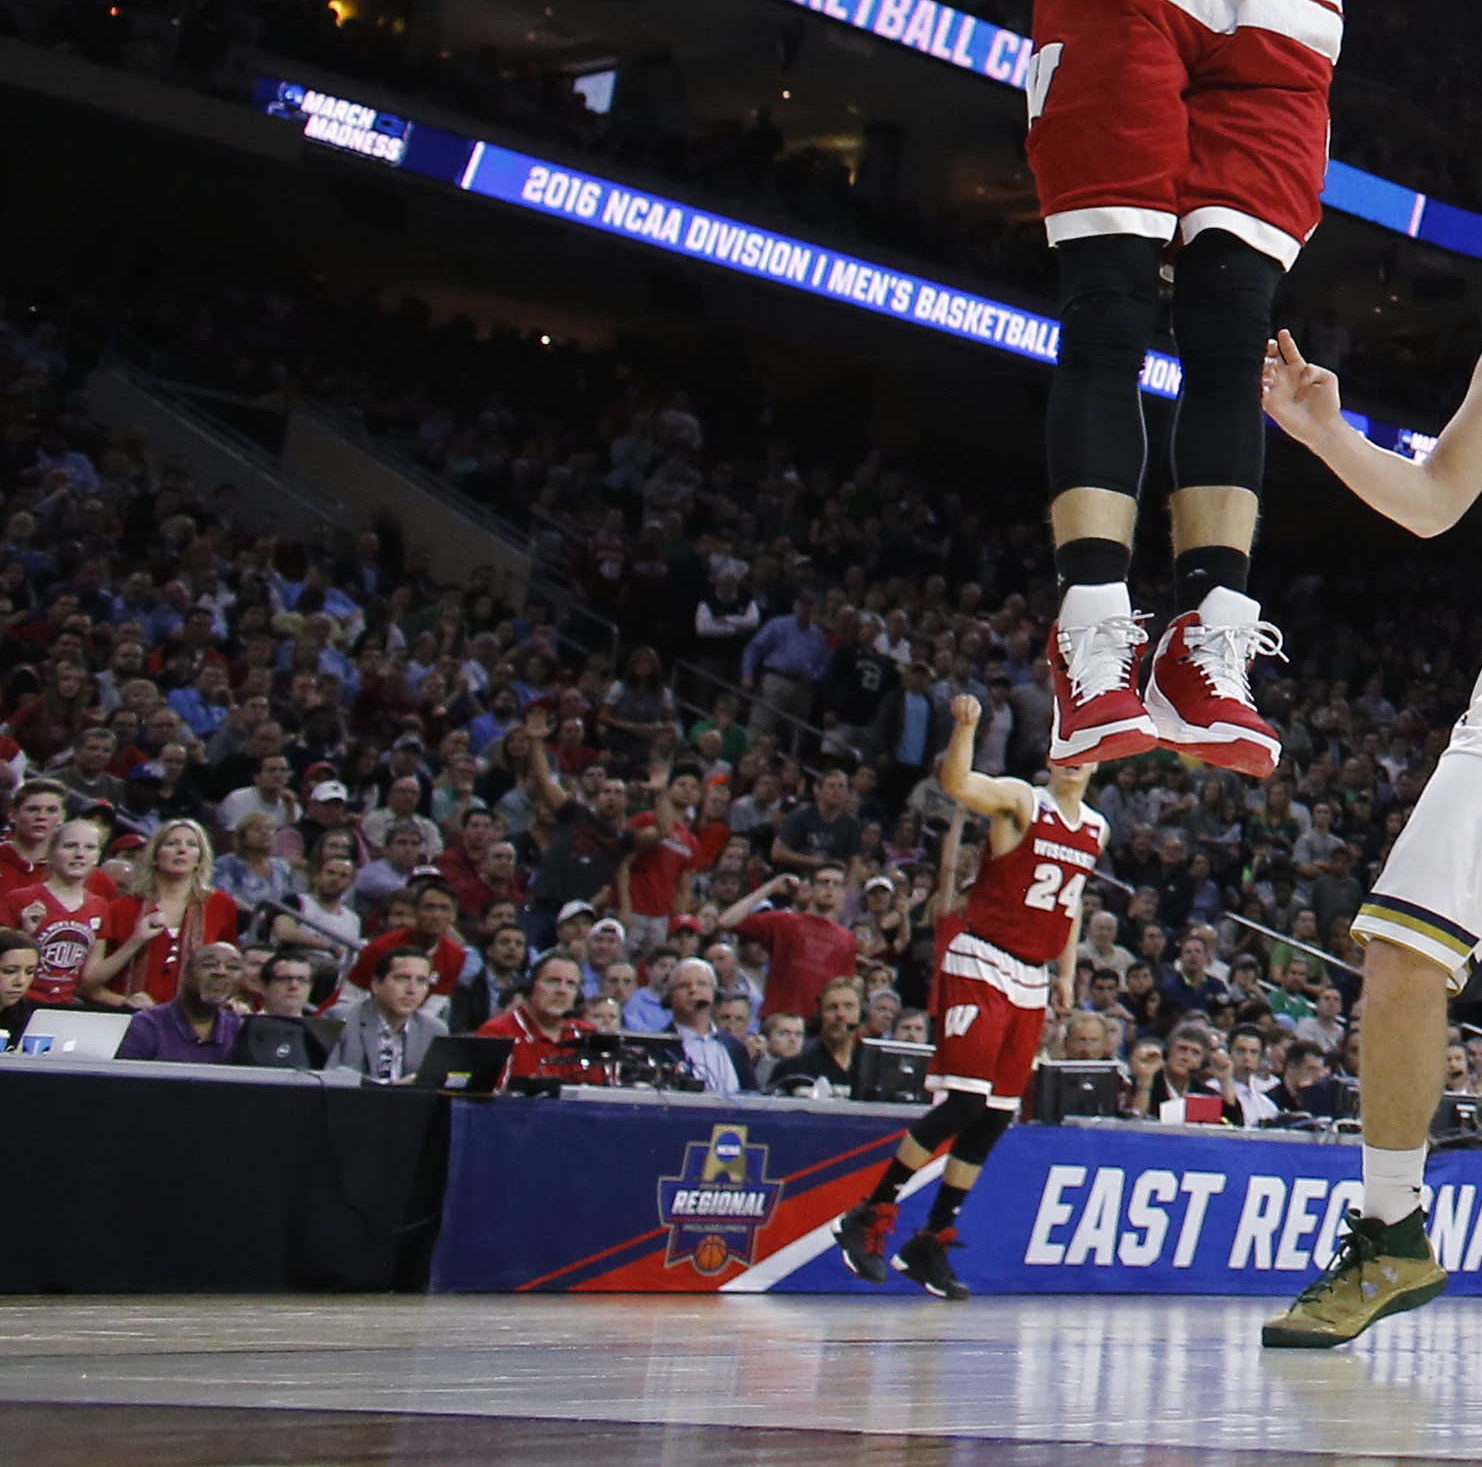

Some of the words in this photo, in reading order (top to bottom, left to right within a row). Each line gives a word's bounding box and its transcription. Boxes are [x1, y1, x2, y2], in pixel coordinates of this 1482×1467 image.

[301, 89, 377, 130] MARCH
[304, 116, 404, 164] MADNESS
[521, 164, 602, 219] 2016
[600, 190, 684, 246] NCAA
[685, 214, 814, 283] DIVISION
[811, 257, 830, 287] I
[828, 262, 915, 313] MEN'S
[914, 285, 1060, 360] BASKETBALL
[1024, 862, 1088, 920] 24
[671, 1189, 767, 1217] REGIONAL
[1024, 1165, 1226, 1268] EAST
